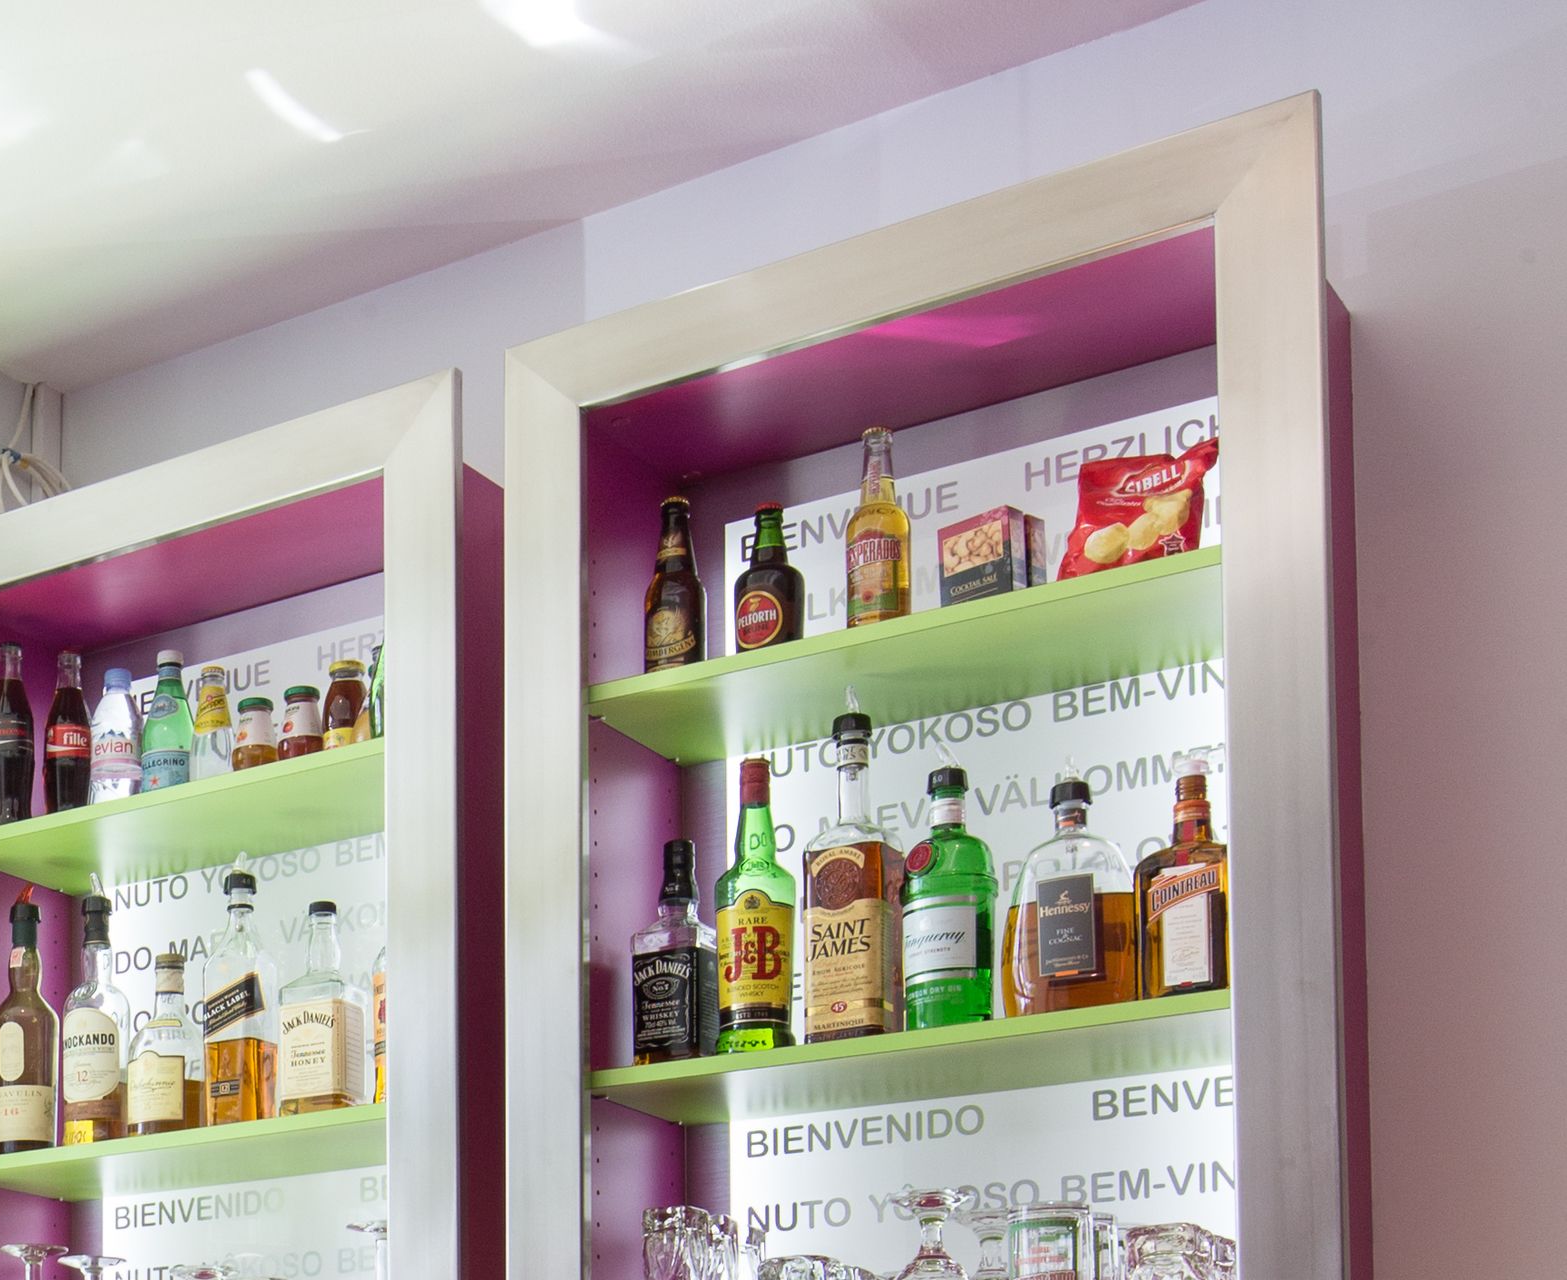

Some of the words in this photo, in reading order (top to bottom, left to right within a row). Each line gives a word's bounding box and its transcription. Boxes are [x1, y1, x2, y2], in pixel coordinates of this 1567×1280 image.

[950, 580, 982, 597] COCKTAIL
[738, 610, 778, 631] PELFORTH
[62, 731, 88, 746] fille
[94, 739, 134, 756] evian
[115, 874, 189, 912] NUTO
[1151, 870, 1217, 913] COINTREAU
[1039, 902, 1091, 919] Hennessy
[738, 916, 769, 926] RARE
[810, 918, 872, 943] SAINT
[806, 935, 872, 962] JAMES
[1049, 935, 1083, 946] COGNAC
[724, 926, 782, 983] J&B
[634, 964, 655, 986] JACK
[655, 958, 693, 980] DANIEL'S
[226, 990, 251, 1009] LABEL
[641, 1000, 680, 1010] Tennessee
[832, 1001, 845, 1012] 45
[282, 1017, 304, 1035] JACK
[303, 1010, 337, 1029] DANIEL'S
[642, 1010, 680, 1022] WHISKEY
[813, 1018, 865, 1031] MARTINIQUE
[290, 1057, 327, 1067] HONEY
[76, 1069, 89, 1083] 12
[746, 1105, 985, 1158] BIENVENIDO
[114, 1187, 285, 1230] BIENVENIDO
